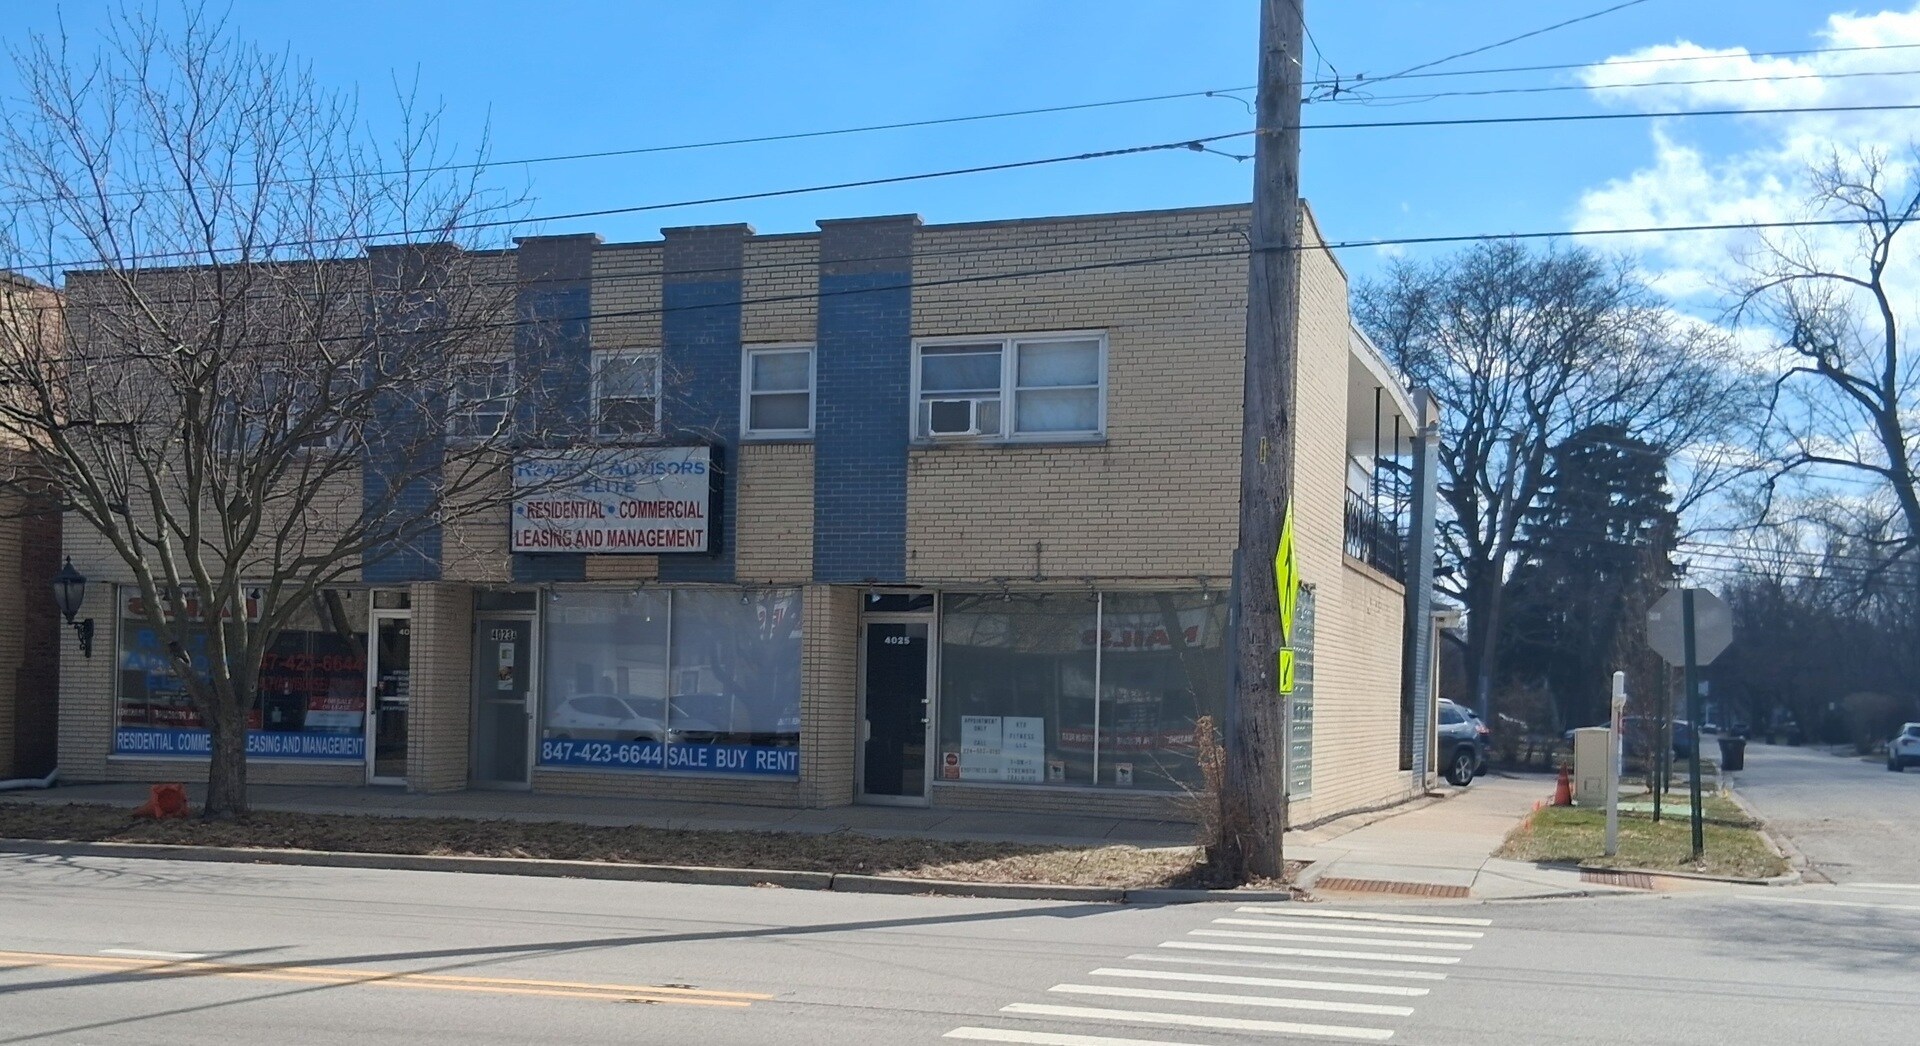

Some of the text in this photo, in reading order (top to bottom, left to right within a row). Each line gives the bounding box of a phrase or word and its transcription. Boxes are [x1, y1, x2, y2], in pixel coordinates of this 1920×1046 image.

[608, 459, 705, 475] ADVISORS
[582, 480, 637, 493] ELITE
[527, 501, 704, 518] RESIDENTIAL COMMERCIAL
[515, 529, 703, 547] LEASING AND MANAGEMENT
[884, 636, 911, 645] 4025
[117, 732, 174, 750] RESIDENTIAL
[178, 733, 211, 751] COMME
[282, 736, 301, 753] AND
[302, 736, 364, 755] MANAGEMENT
[542, 741, 798, 770] 847-423-6644 SALE BUY RENT
